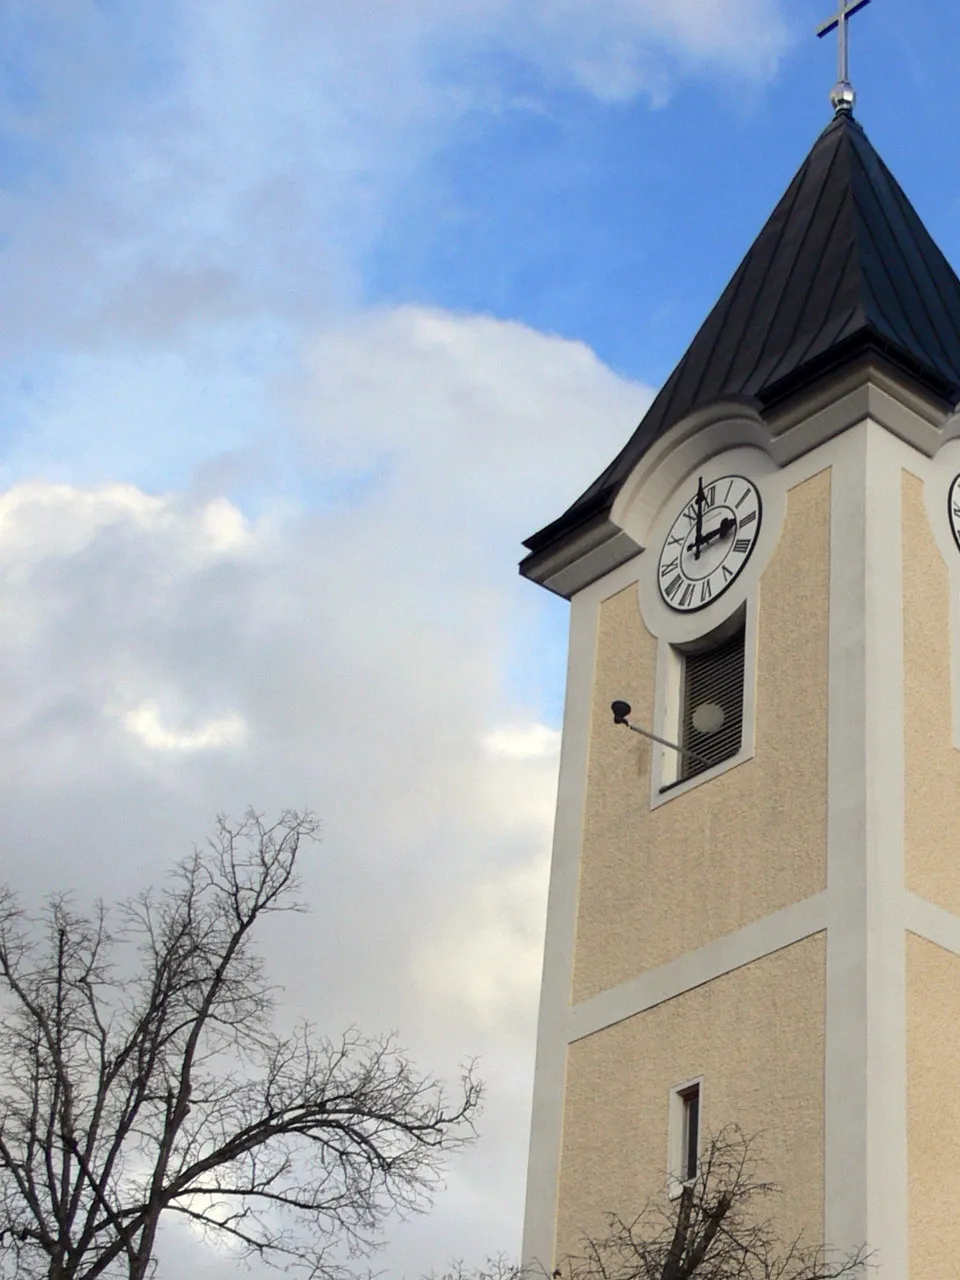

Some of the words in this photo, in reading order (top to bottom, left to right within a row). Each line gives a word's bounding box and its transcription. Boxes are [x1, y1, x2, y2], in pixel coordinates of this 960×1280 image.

[724, 480, 733, 503] I
[739, 511, 756, 528] III
[668, 535, 684, 546] X
[733, 539, 751, 553] IIII
[661, 557, 678, 578] IX
[722, 564, 733, 582] V
[701, 579, 712, 602] VI
